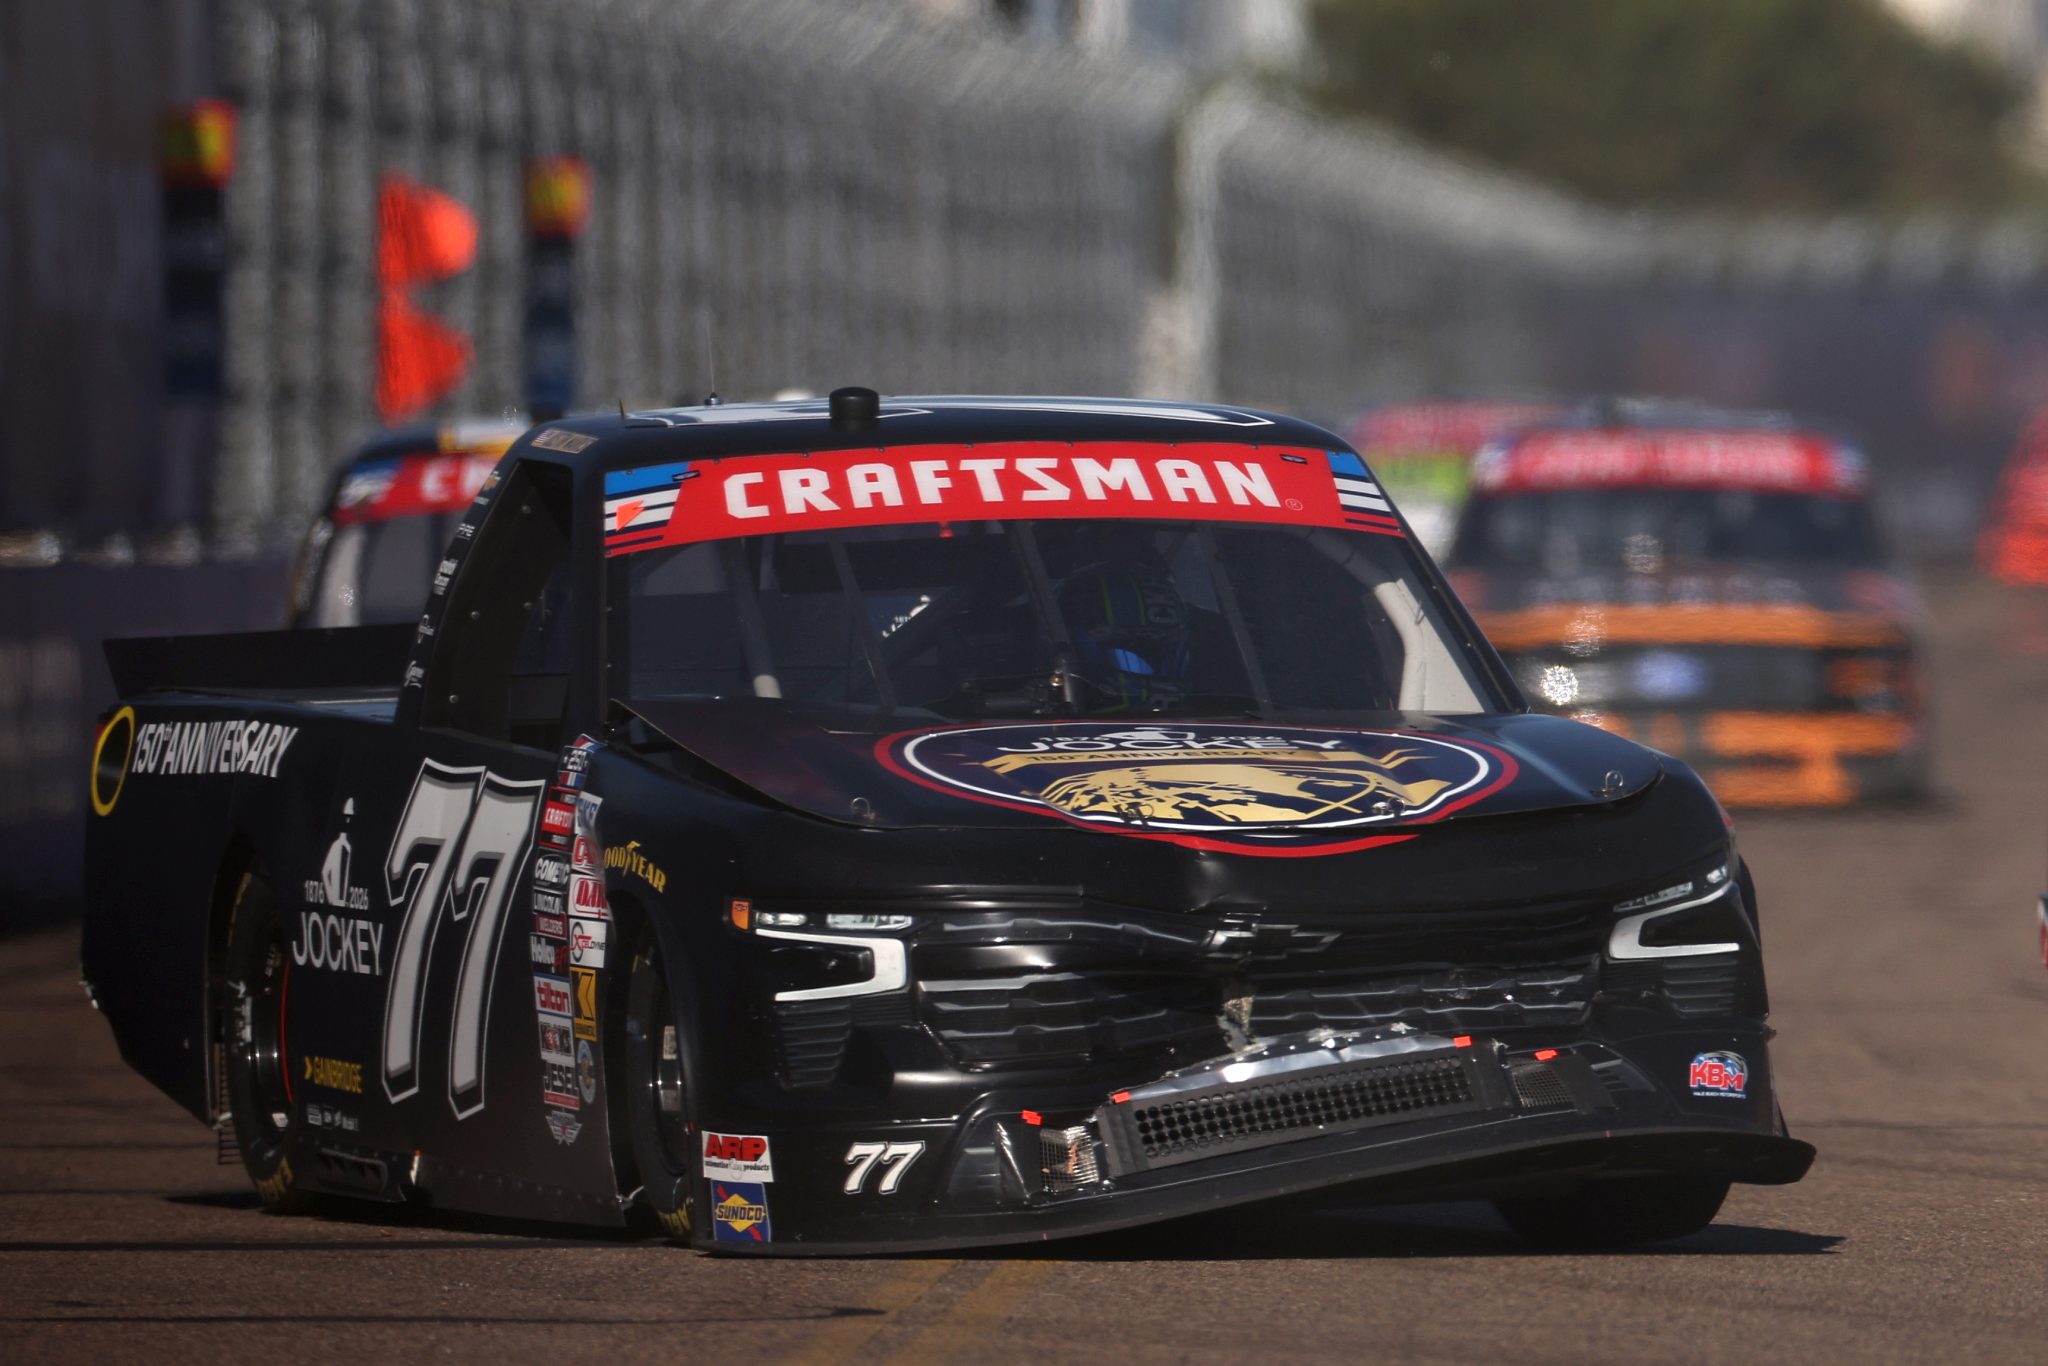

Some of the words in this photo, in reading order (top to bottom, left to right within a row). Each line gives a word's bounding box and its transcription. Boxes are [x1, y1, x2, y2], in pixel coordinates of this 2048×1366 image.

[723, 457, 1282, 520] CRAFTSMAN
[160, 719, 299, 778] ANNIVERSARY
[997, 740, 1341, 753] JOCKEY
[1087, 750, 1297, 761] ANNIVERSARY
[603, 841, 667, 894] OODYEAR
[304, 880, 324, 903] 1876
[350, 886, 369, 911] 2026
[292, 911, 384, 976] JOCKEY
[382, 757, 546, 1121] 77
[1689, 1060, 1745, 1092] KBM
[704, 1133, 767, 1162] ARP
[844, 1140, 926, 1195] 77
[716, 1204, 763, 1222] SUNOCO
